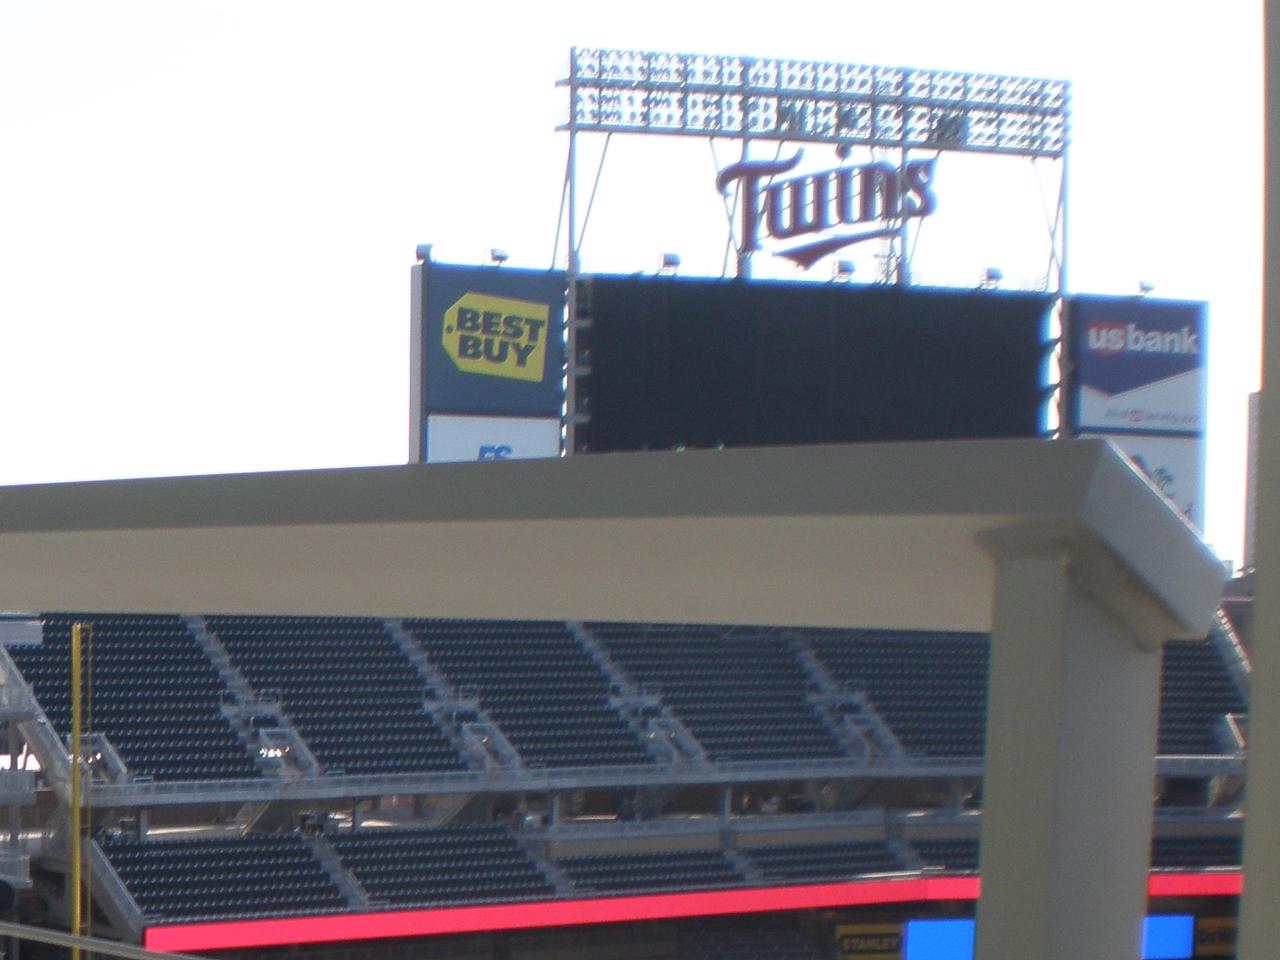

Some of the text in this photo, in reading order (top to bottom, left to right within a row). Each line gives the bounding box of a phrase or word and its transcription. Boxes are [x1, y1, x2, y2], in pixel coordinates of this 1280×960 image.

[716, 143, 937, 251] Twins
[456, 306, 545, 343] BEST
[457, 334, 537, 368] BUY
[841, 937, 899, 952] STANLEY
